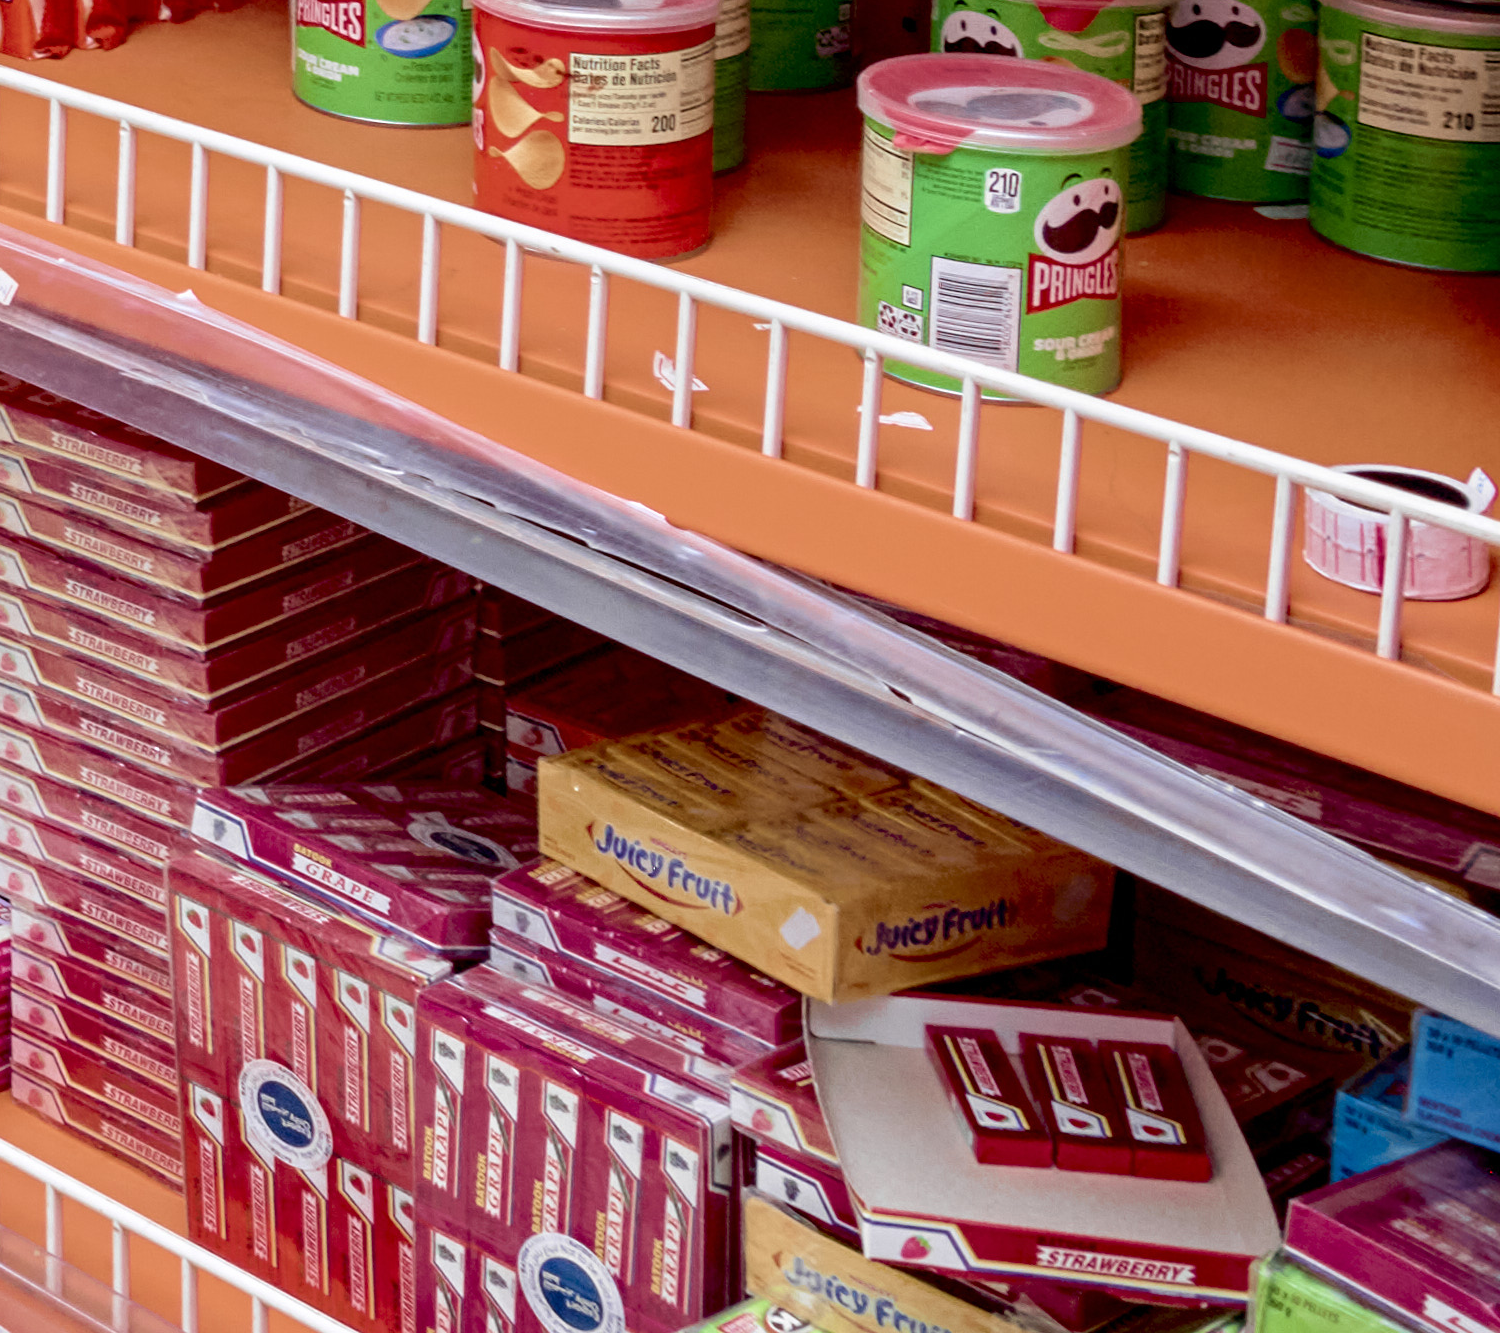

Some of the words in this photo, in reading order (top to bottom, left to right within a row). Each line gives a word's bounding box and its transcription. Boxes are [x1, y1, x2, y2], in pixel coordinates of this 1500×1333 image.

[573, 55, 622, 72] Nutrition
[625, 58, 661, 73] Facts
[1364, 33, 1417, 57] Nutrition
[1420, 45, 1457, 66] Facts
[611, 71, 626, 87] de
[650, 112, 677, 134] 200
[1442, 109, 1475, 133] 210
[988, 170, 1020, 197] 210
[54, 432, 139, 472] STRAWBERRY
[304, 862, 378, 907] GRAPE
[594, 821, 664, 880] Juicy
[666, 862, 738, 916] Fruit
[864, 915, 938, 958] Juicy
[941, 897, 1011, 939] Fruit
[1043, 1247, 1190, 1283] STRAWBERRY
